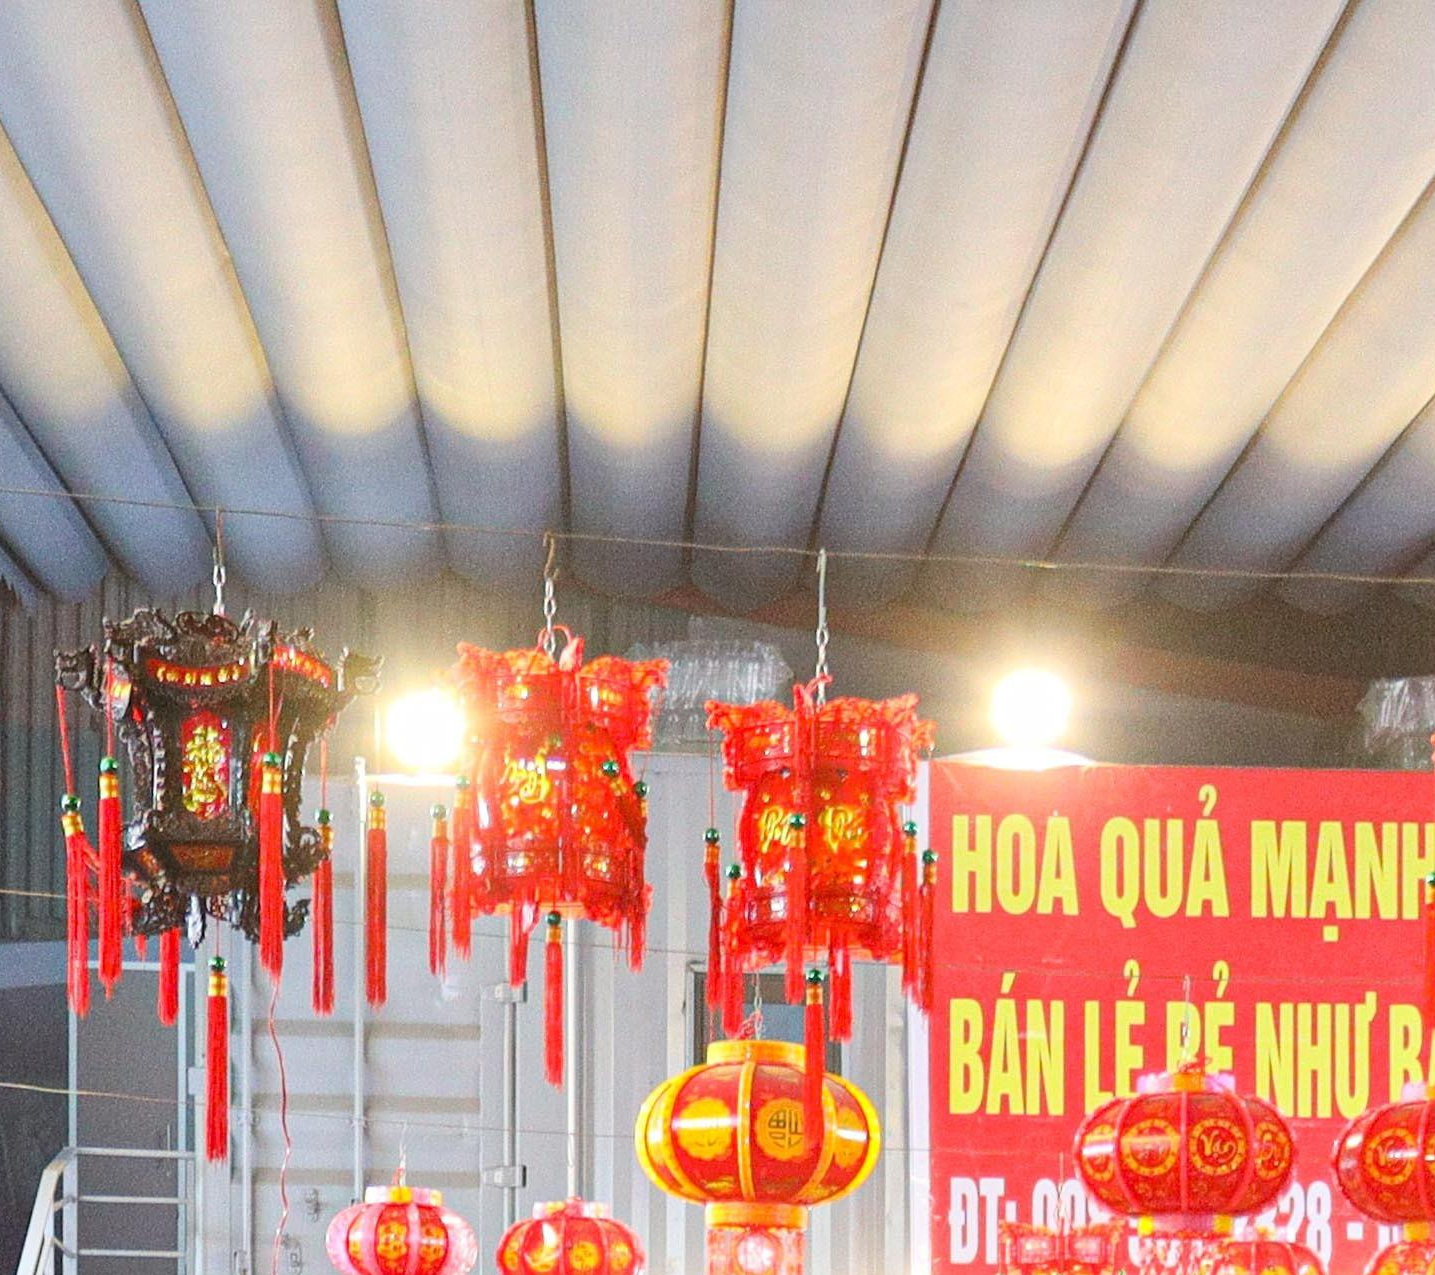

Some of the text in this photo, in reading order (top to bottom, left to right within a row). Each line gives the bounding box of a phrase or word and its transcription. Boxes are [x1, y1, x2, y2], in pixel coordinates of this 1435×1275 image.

[951, 813, 1080, 916] HOA
[1100, 783, 1230, 929] QUẢ
[948, 971, 1065, 1116] BÁN
[1084, 958, 1146, 1114] LẺ
[1255, 990, 1377, 1120] NHƯ
